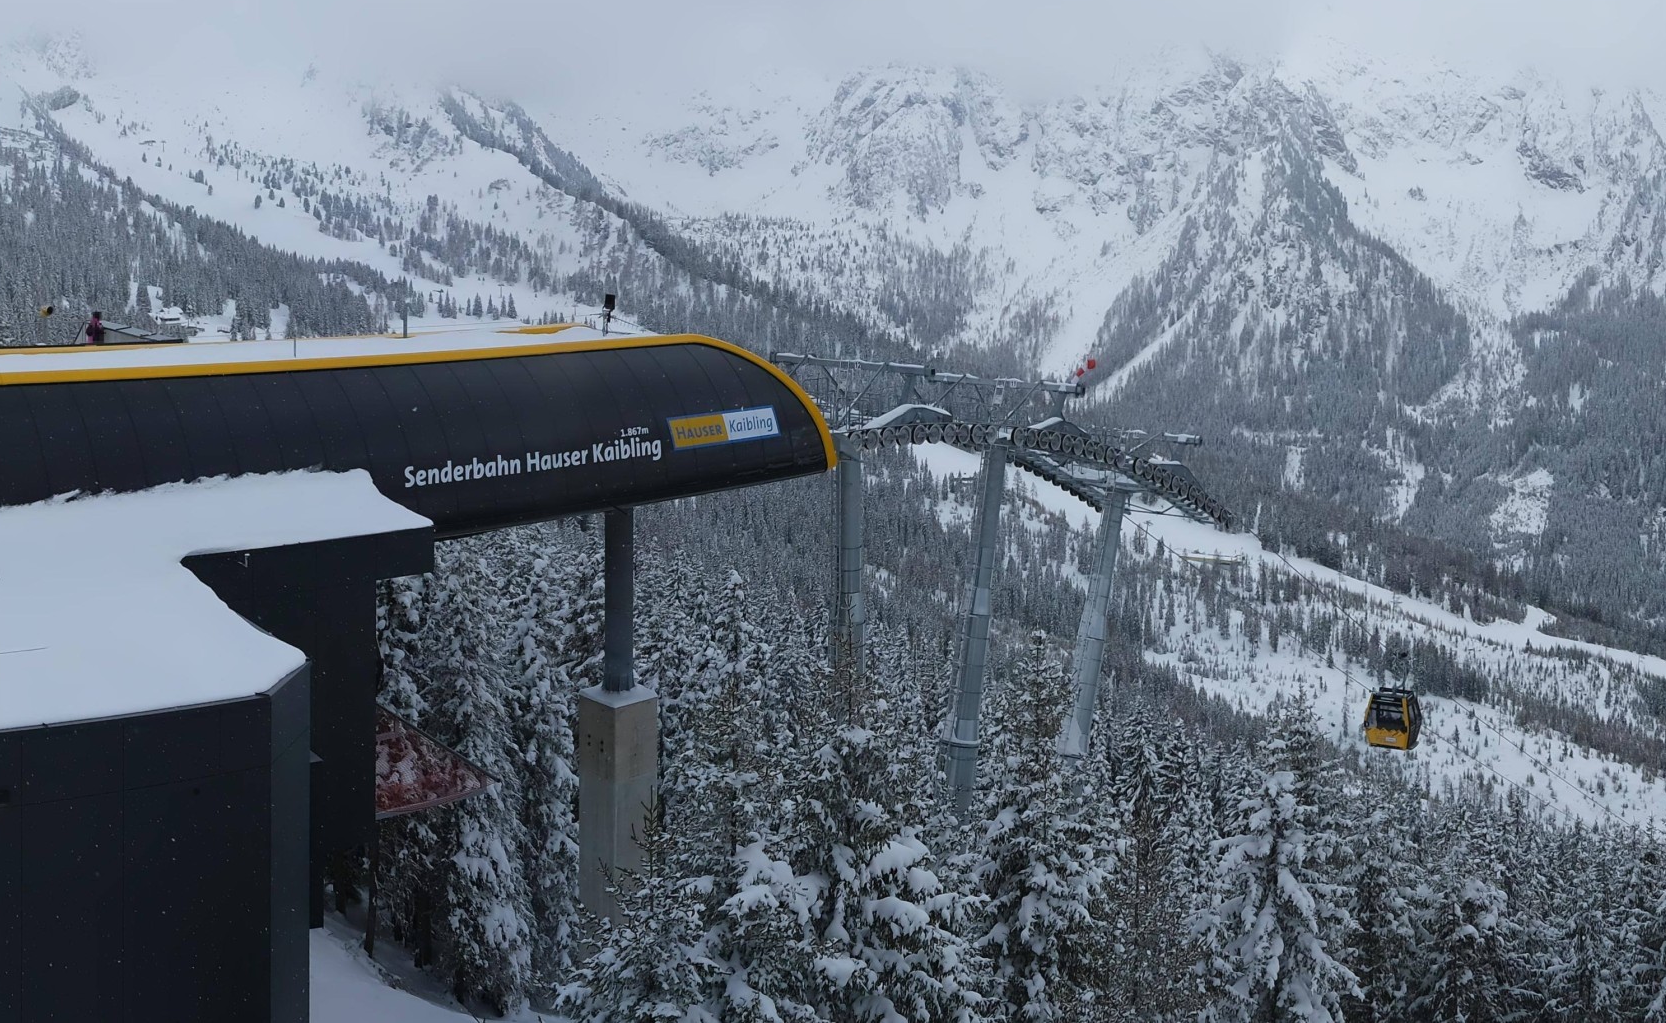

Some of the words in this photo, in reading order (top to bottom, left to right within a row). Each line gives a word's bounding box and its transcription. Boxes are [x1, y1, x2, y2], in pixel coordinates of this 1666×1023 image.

[620, 427, 649, 437] 1.867m
[676, 424, 723, 439] HAUSER
[728, 415, 773, 433] Kaibling
[404, 454, 521, 488] Senderbahn
[526, 449, 588, 473] Hauser
[592, 436, 662, 463] Kaibling
